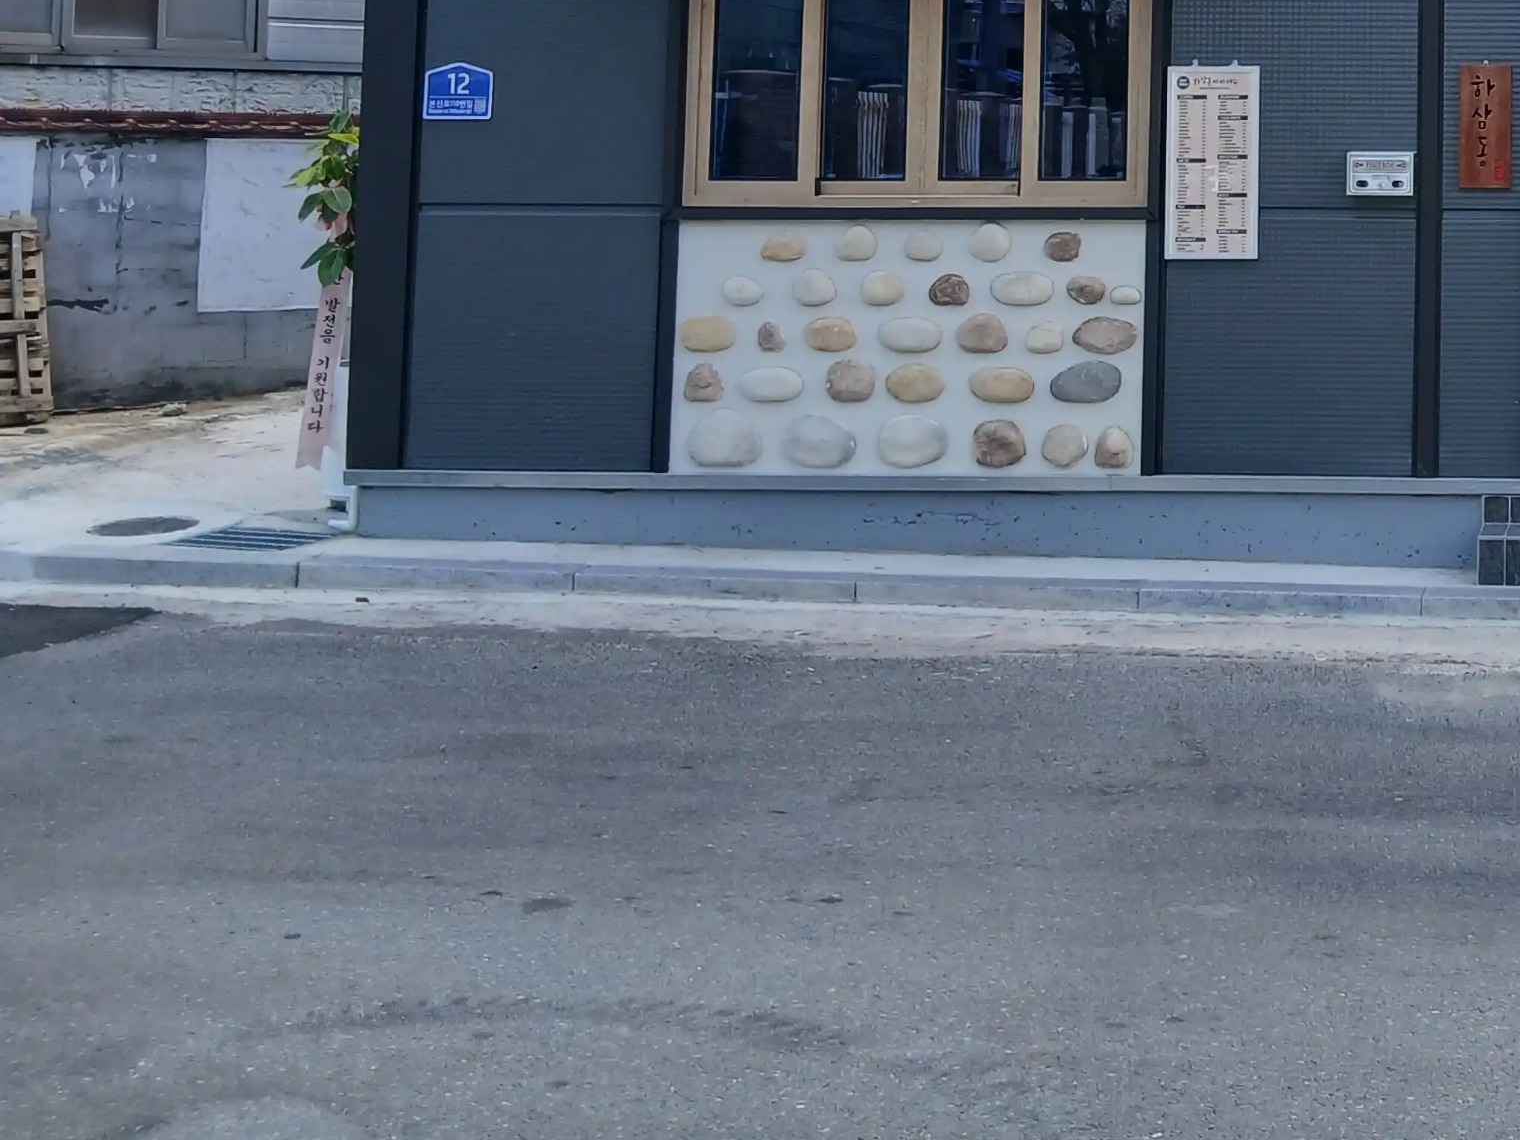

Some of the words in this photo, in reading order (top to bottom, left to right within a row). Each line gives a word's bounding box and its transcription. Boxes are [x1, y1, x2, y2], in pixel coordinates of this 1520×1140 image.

[447, 72, 471, 95] 12
[1470, 74, 1496, 168] 하삼동
[319, 297, 341, 345] 발전을
[307, 356, 331, 434] 기원합니다
